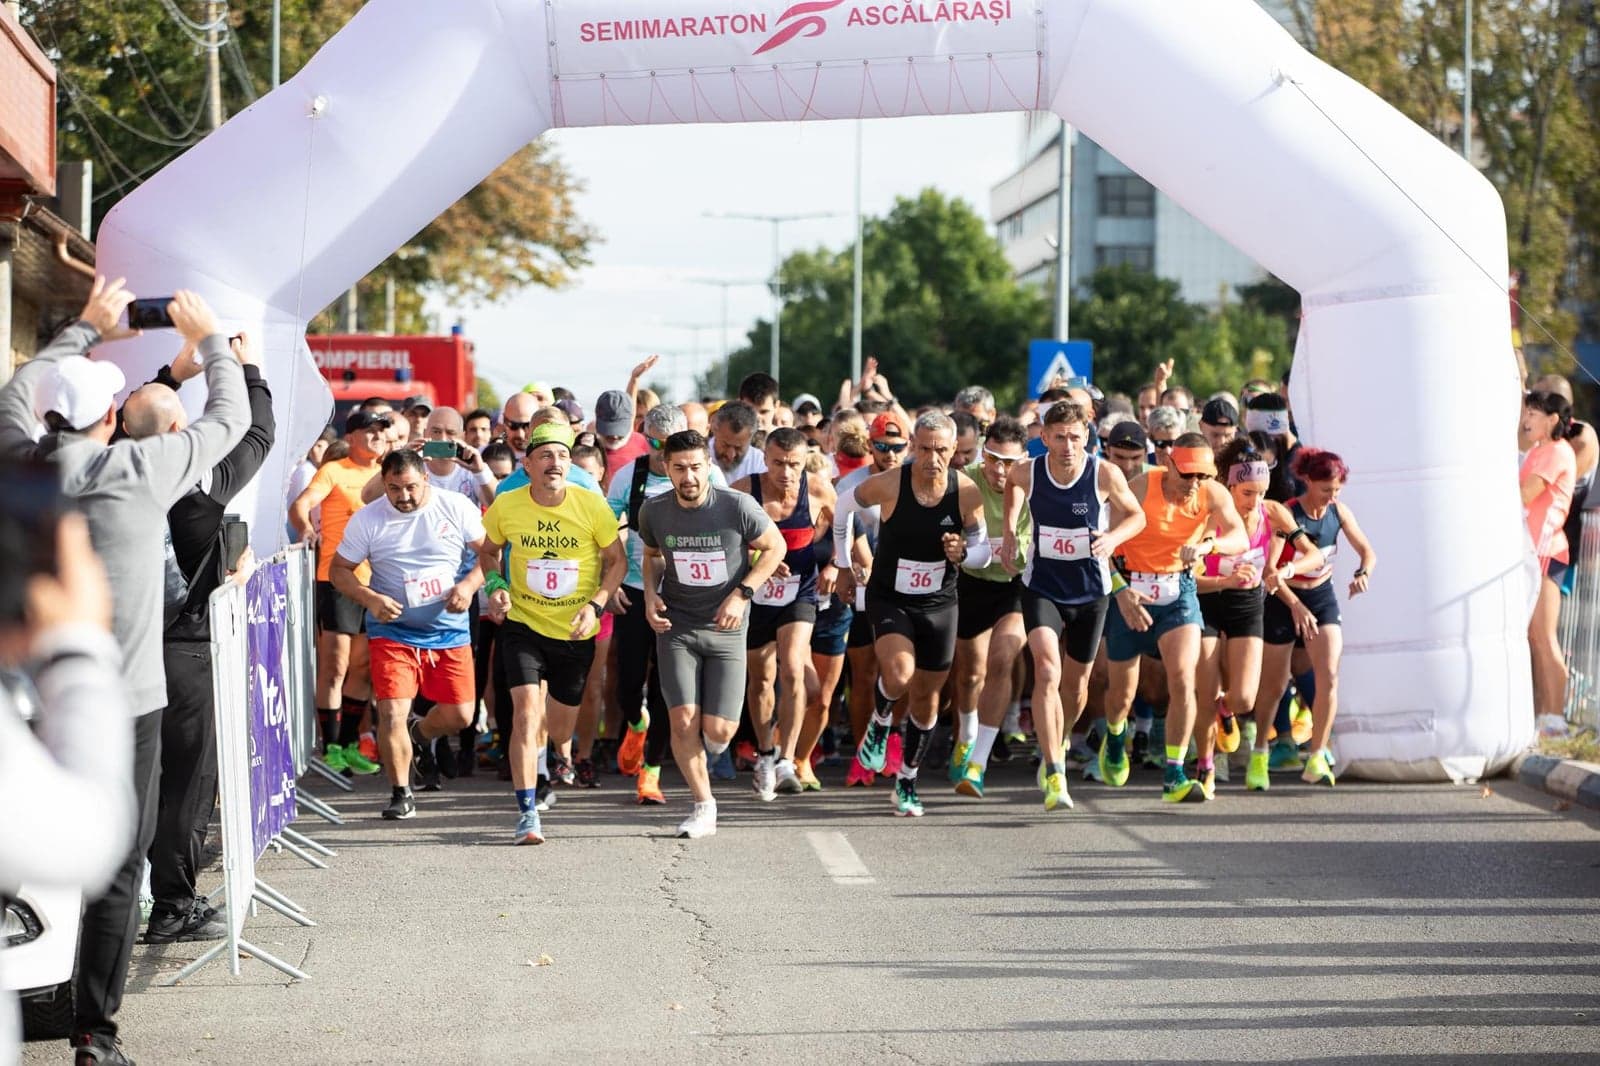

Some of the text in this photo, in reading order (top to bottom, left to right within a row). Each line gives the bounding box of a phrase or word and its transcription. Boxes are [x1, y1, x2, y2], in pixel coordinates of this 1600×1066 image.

[580, 13, 766, 42] SEMIMARATON
[537, 520, 560, 532] DAC
[521, 535, 579, 549] WARRIOR
[676, 535, 722, 548] SPARTAN
[1052, 538, 1075, 555] 46
[690, 562, 711, 580] 31
[546, 571, 557, 590] 8
[910, 572, 932, 588] 36
[420, 579, 442, 599] 30
[764, 583, 785, 599] 38
